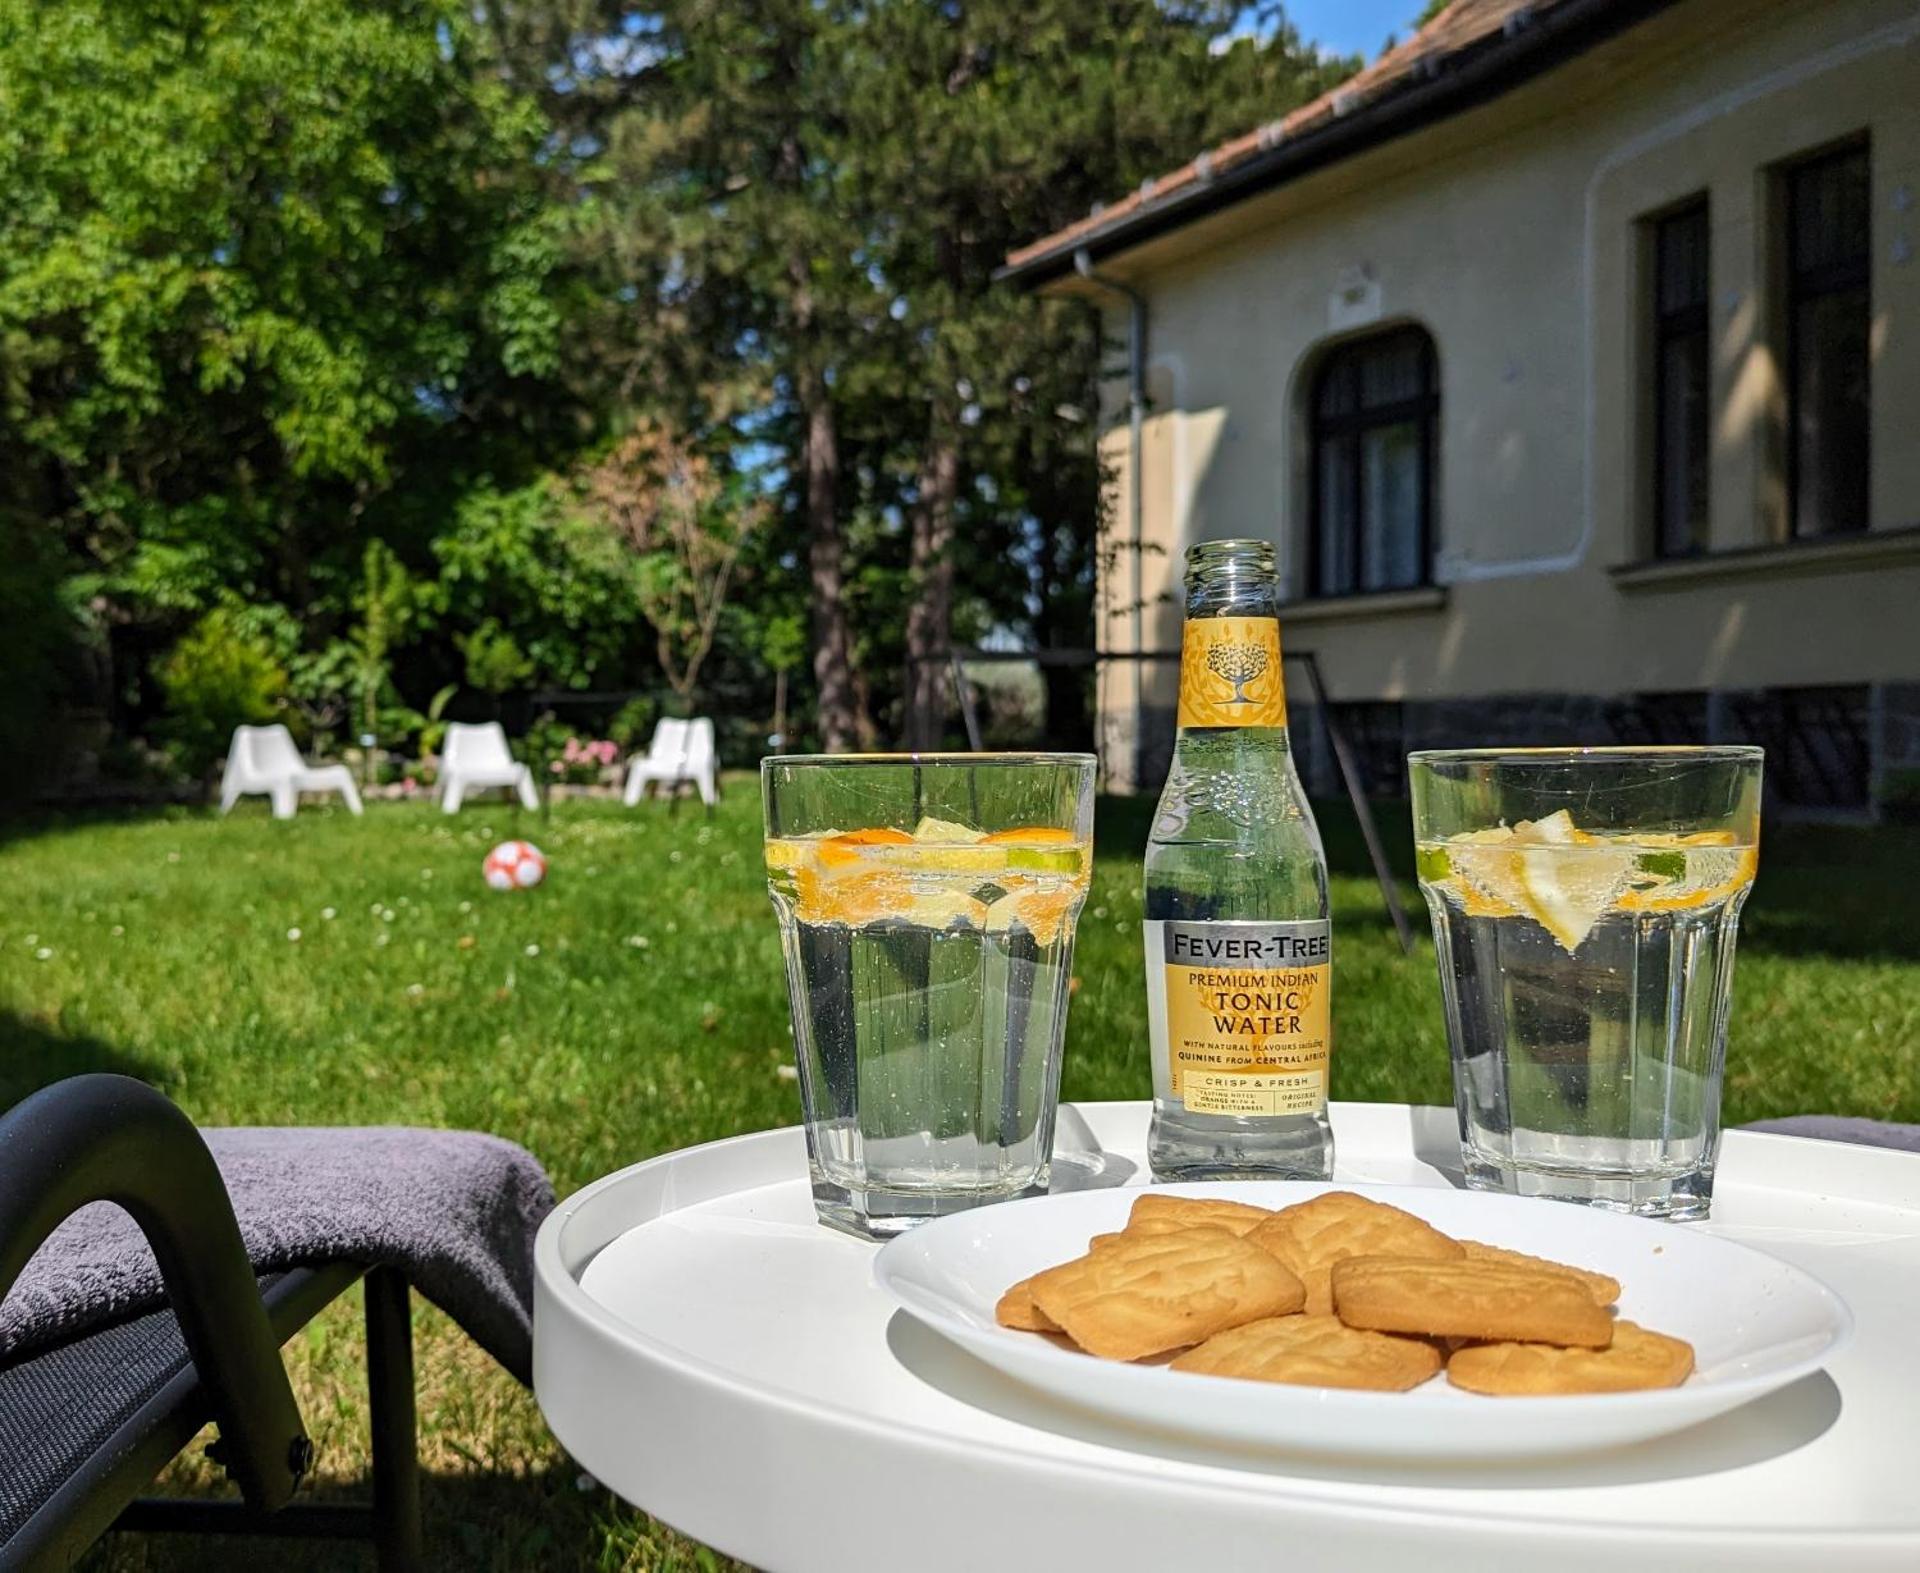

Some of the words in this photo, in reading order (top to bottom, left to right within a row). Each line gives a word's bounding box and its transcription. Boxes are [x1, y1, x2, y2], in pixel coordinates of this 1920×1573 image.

[1174, 933, 1328, 959] FEVER-TREE
[1189, 973, 1265, 988] PREMIUM
[1271, 972, 1318, 987] INDIAN
[1216, 991, 1299, 1011] TONIC
[1213, 1016, 1302, 1035] WATER
[1183, 1039, 1206, 1048] WITH
[1207, 1041, 1250, 1051] NATURAL
[1253, 1042, 1297, 1052] FLAVOURS
[1178, 1051, 1222, 1062] QUININE
[1226, 1056, 1252, 1065] FROM
[1256, 1056, 1301, 1064] CENTRAL
[1304, 1051, 1327, 1062] AFRICA
[1205, 1077, 1247, 1087] CRISP
[1254, 1079, 1262, 1087] &
[1269, 1077, 1308, 1087] FRESH
